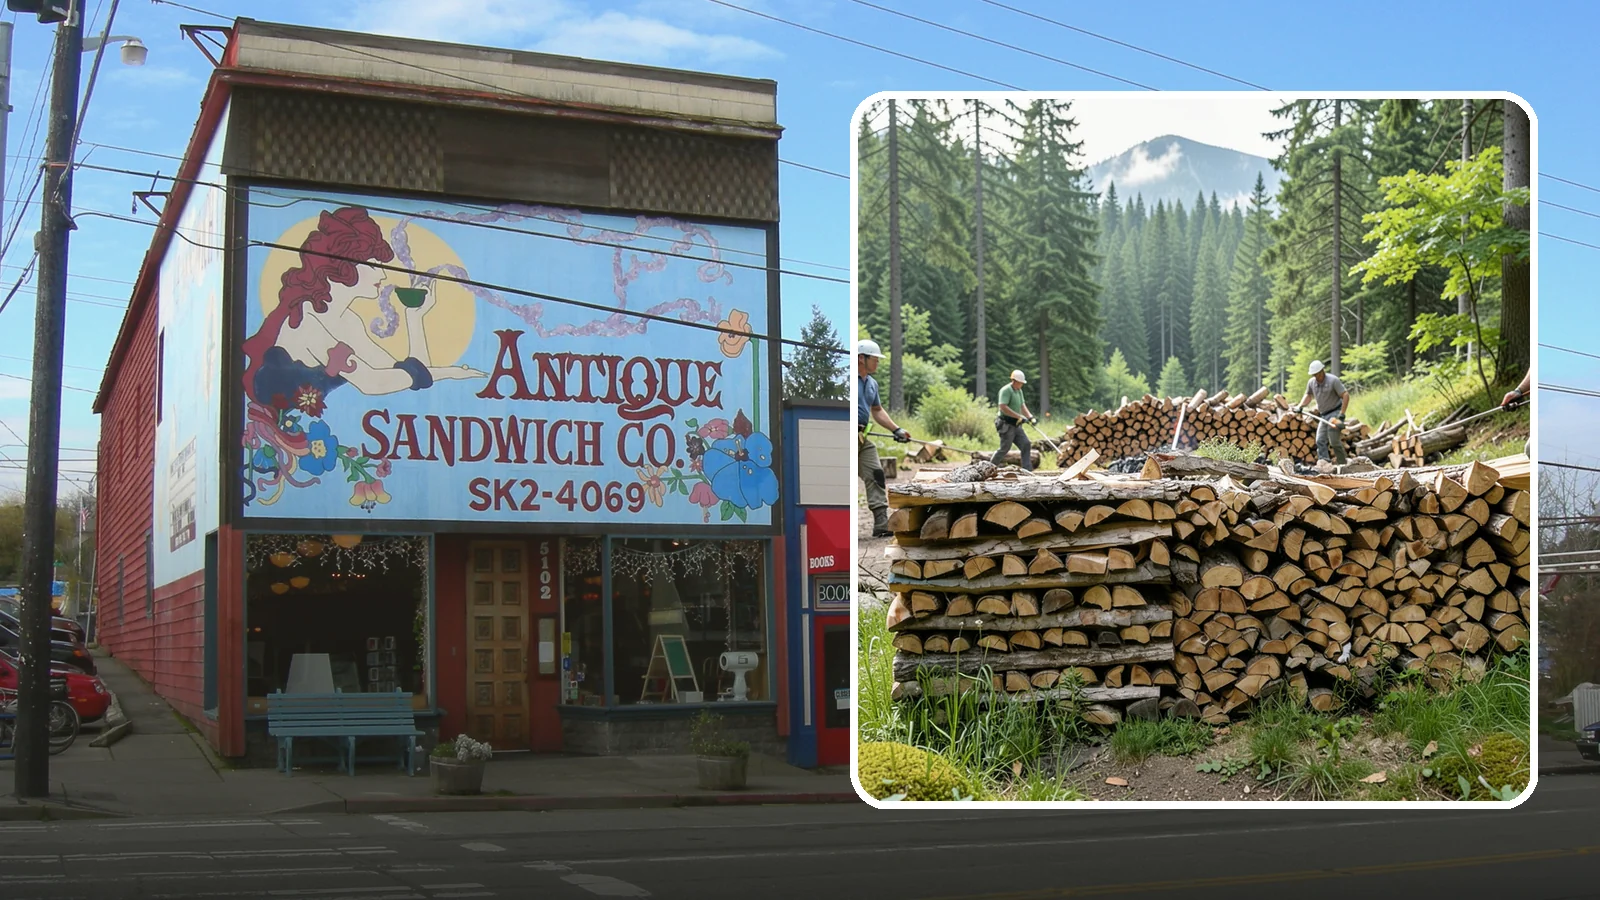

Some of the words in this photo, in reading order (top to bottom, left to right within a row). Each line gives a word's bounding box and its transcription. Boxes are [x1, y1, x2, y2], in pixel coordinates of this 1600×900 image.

[475, 329, 723, 420] ANTIQUE
[361, 408, 604, 467] SANDWICH
[617, 422, 685, 469] CO.
[468, 477, 645, 513] SK2-4069
[540, 541, 552, 600] 5102
[809, 555, 835, 569] BOOKS
